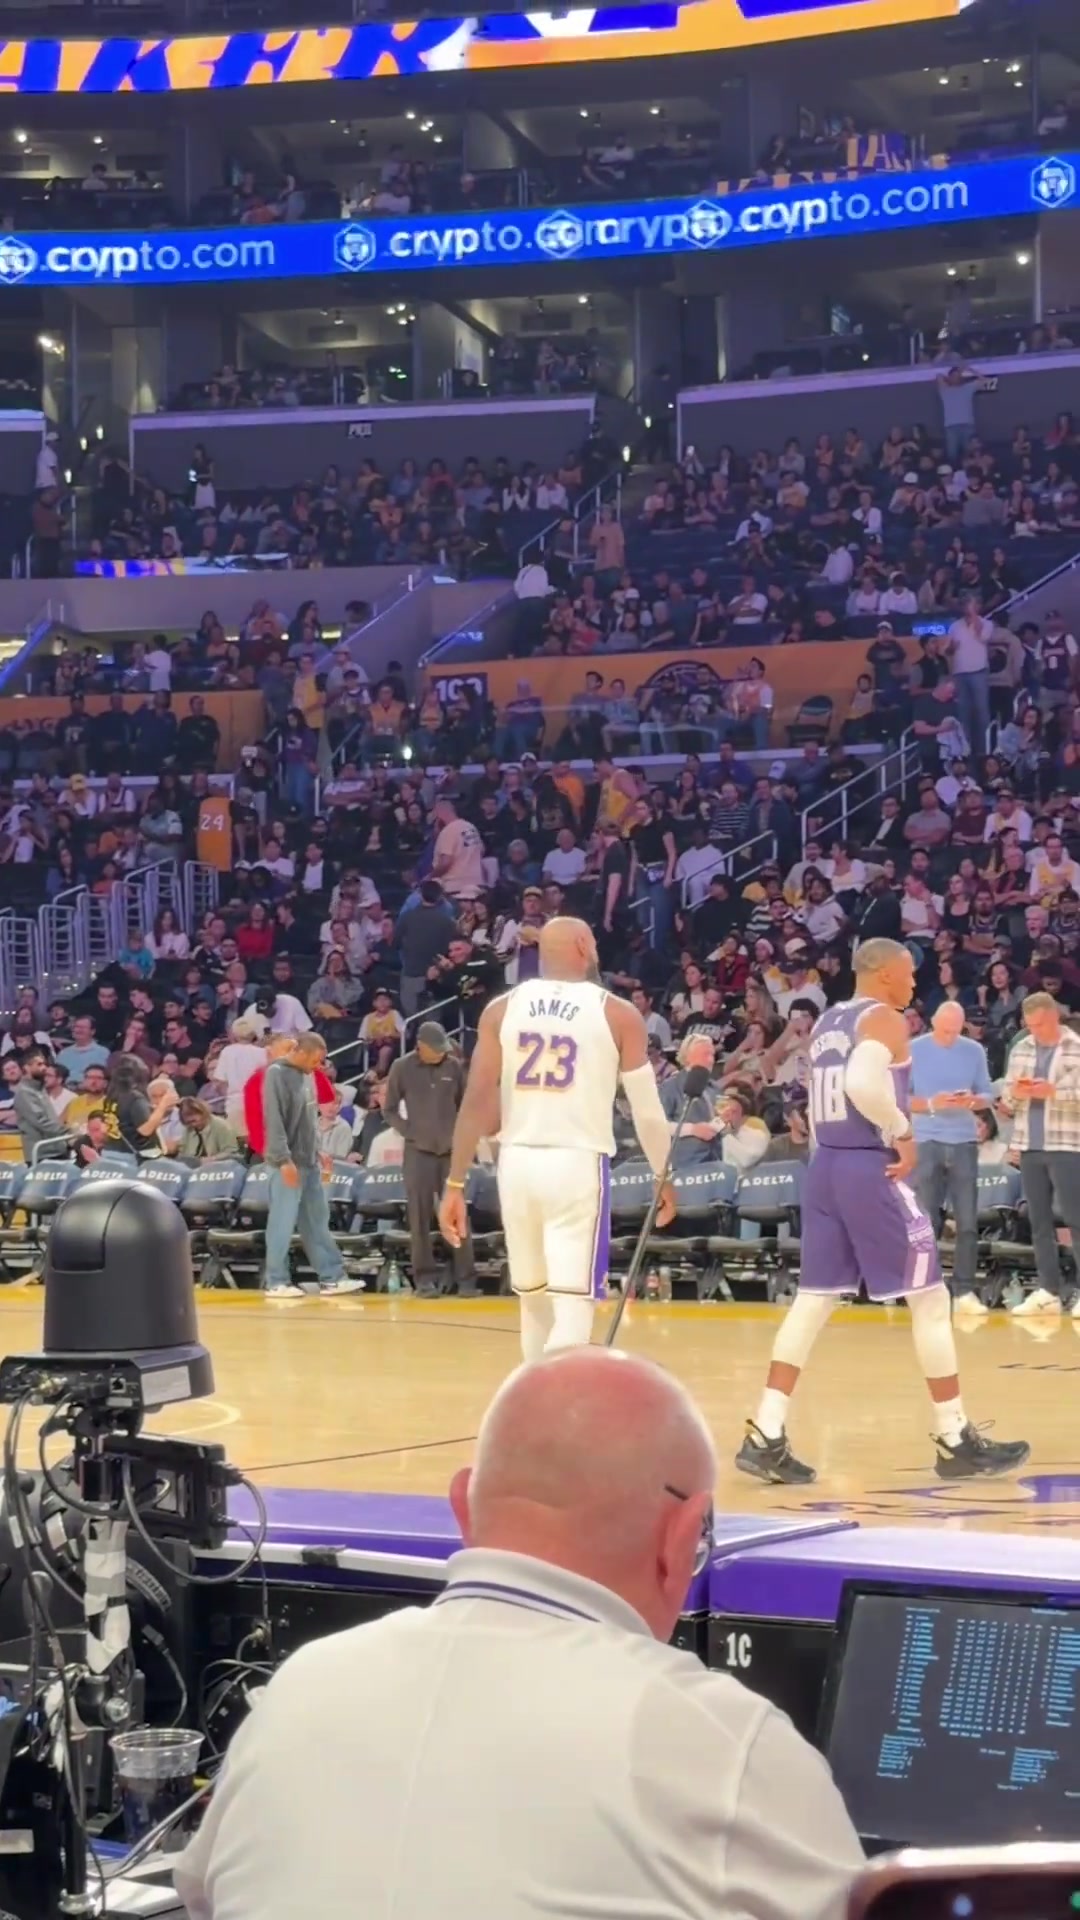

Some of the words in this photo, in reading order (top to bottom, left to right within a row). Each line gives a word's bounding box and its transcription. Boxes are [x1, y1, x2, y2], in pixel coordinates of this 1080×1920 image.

[201, 814, 224, 831] 24
[529, 999, 580, 1021] JAMES
[516, 1031, 578, 1092] 23
[812, 1065, 847, 1122] 18
[36, 1171, 68, 1180] DELTA
[149, 1171, 181, 1184] DELTA
[200, 1171, 235, 1181] DELTA
[329, 1174, 354, 1185] ELTA
[686, 1171, 726, 1185] DELTA
[753, 1174, 795, 1186] DELTA
[976, 1175, 1008, 1187] ELTA
[726, 1632, 752, 1668] 1C
